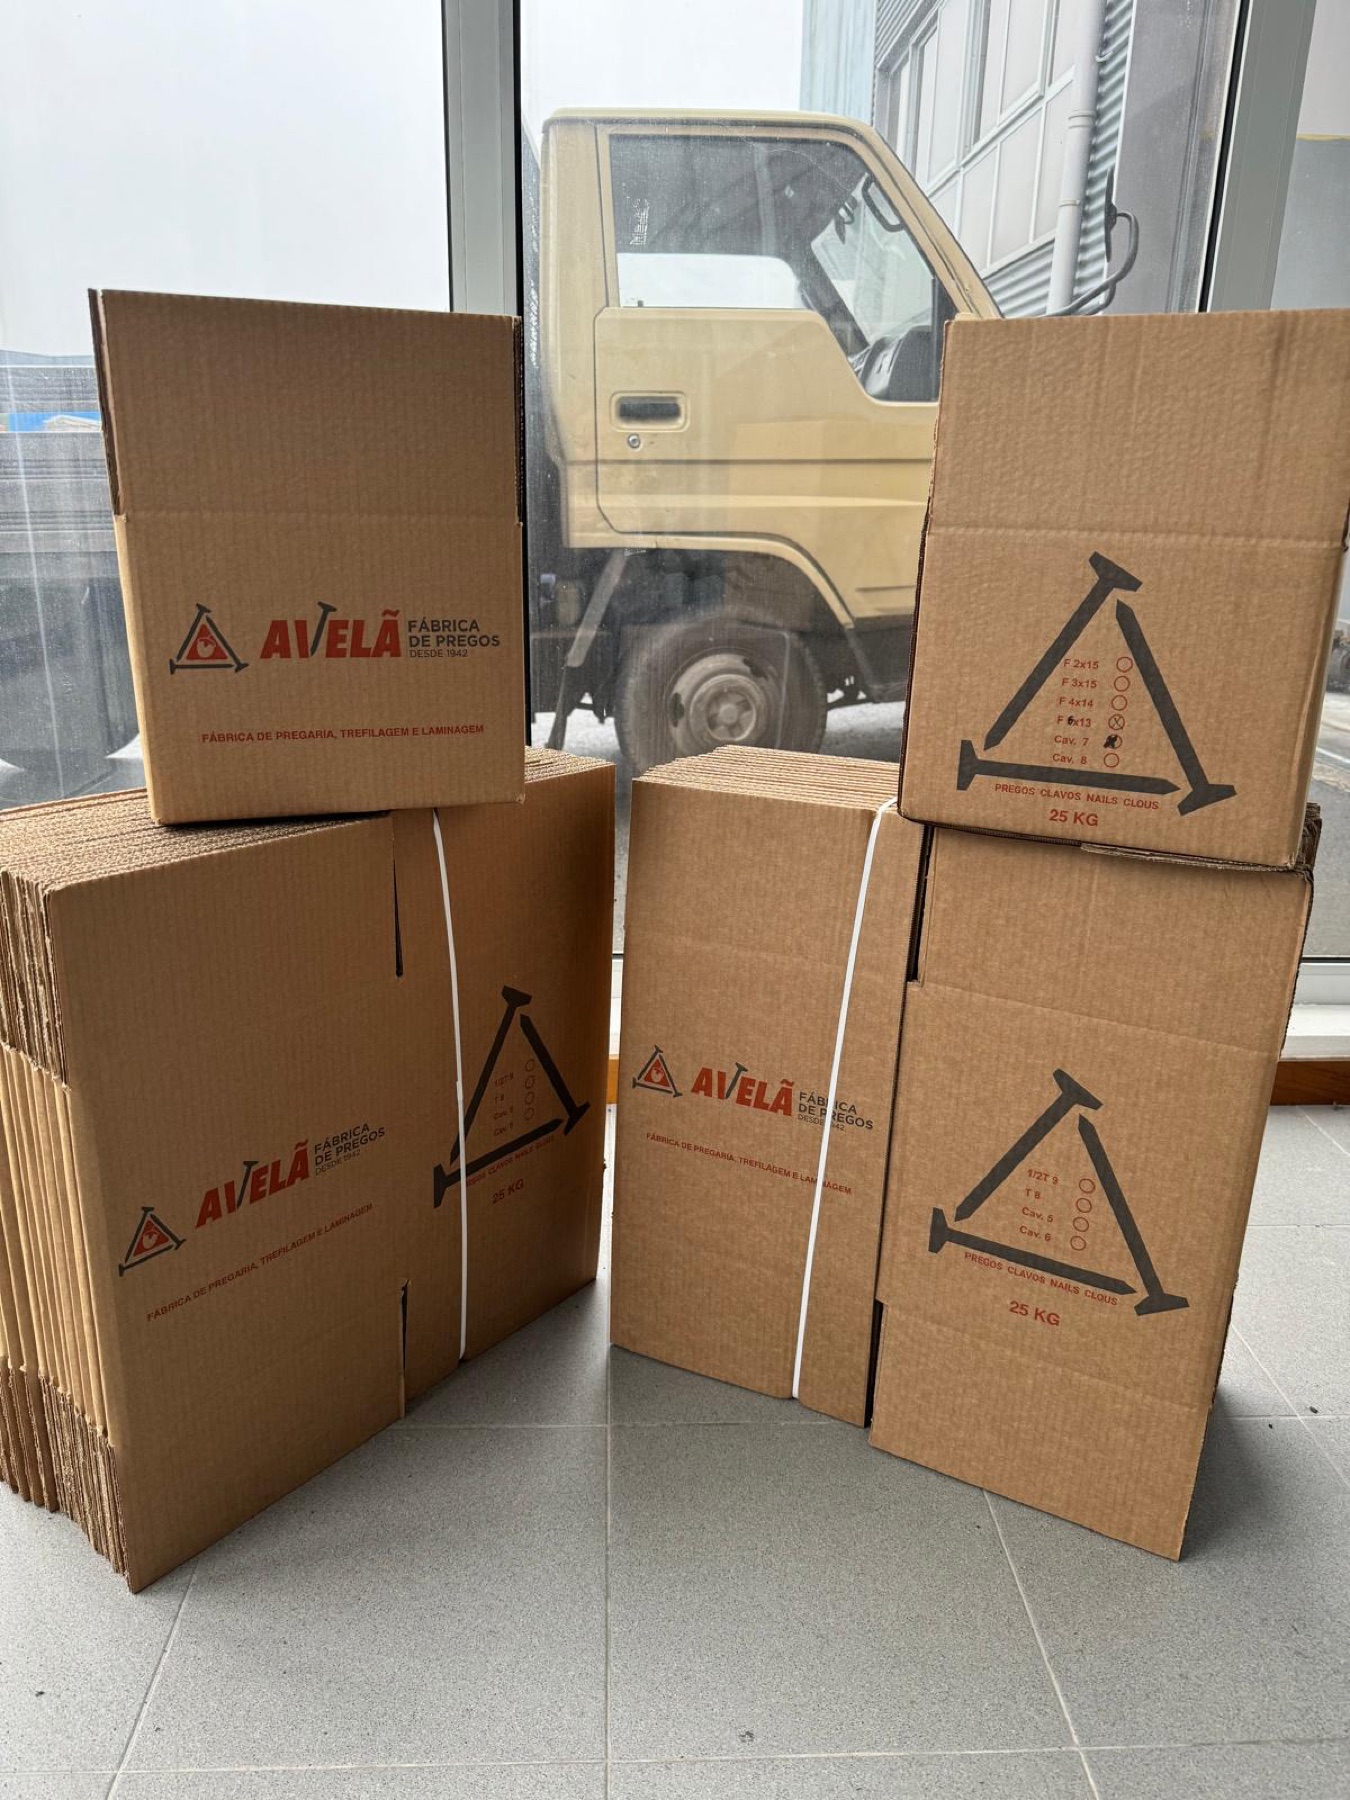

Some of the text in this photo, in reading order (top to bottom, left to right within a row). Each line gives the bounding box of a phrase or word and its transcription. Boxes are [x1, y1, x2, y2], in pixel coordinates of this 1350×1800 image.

[260, 601, 402, 659] AVELÃ
[408, 617, 480, 632] FÁBRICA
[409, 635, 500, 647] DE PREGOS
[410, 649, 468, 658] DESDE 1942
[1063, 658, 1099, 669] F 2x15
[1061, 677, 1097, 689] F 3x15
[1059, 696, 1094, 708] F 4x14
[1056, 715, 1063, 725] F
[202, 725, 484, 743] FÁBRICA DE PREGARIA, TREFILAGEM E LAMINAGEM
[1054, 735, 1089, 746] Cav. 7
[1052, 753, 1087, 765] Cav. 8
[995, 783, 1160, 810] PREGOS CLAVOS NAILS CLOUS
[1049, 808, 1099, 827] 25 KG
[691, 1062, 794, 1117] AVELÃ
[798, 1104, 816, 1116] DE
[800, 1091, 857, 1115] FÁBICA
[315, 1123, 370, 1154] FÁBRICA
[315, 1127, 386, 1166] DE PREGOS
[315, 1158, 342, 1176] DESDE
[681, 1141, 692, 1151] DE
[694, 1144, 737, 1163] PREGARIA,
[738, 1156, 791, 1178] TREFILAGEM
[792, 1171, 799, 1180] E
[195, 1139, 309, 1229] AVELÃ
[1027, 1168, 1059, 1185] 1/2T 9
[492, 1178, 524, 1205] 25 KG
[1025, 1187, 1041, 1200] T 8
[1021, 1206, 1054, 1223] Cav. 5
[1044, 1233, 1052, 1242] 6
[193, 1286, 207, 1299] DE
[260, 1232, 316, 1265] TREFILAGEM
[317, 1228, 323, 1237] E
[324, 1203, 373, 1234] LAMINAGEM
[964, 1251, 1118, 1306] PREGOS CLAVOS NAILS CLOUS
[1009, 1300, 1061, 1327] 25 KG
